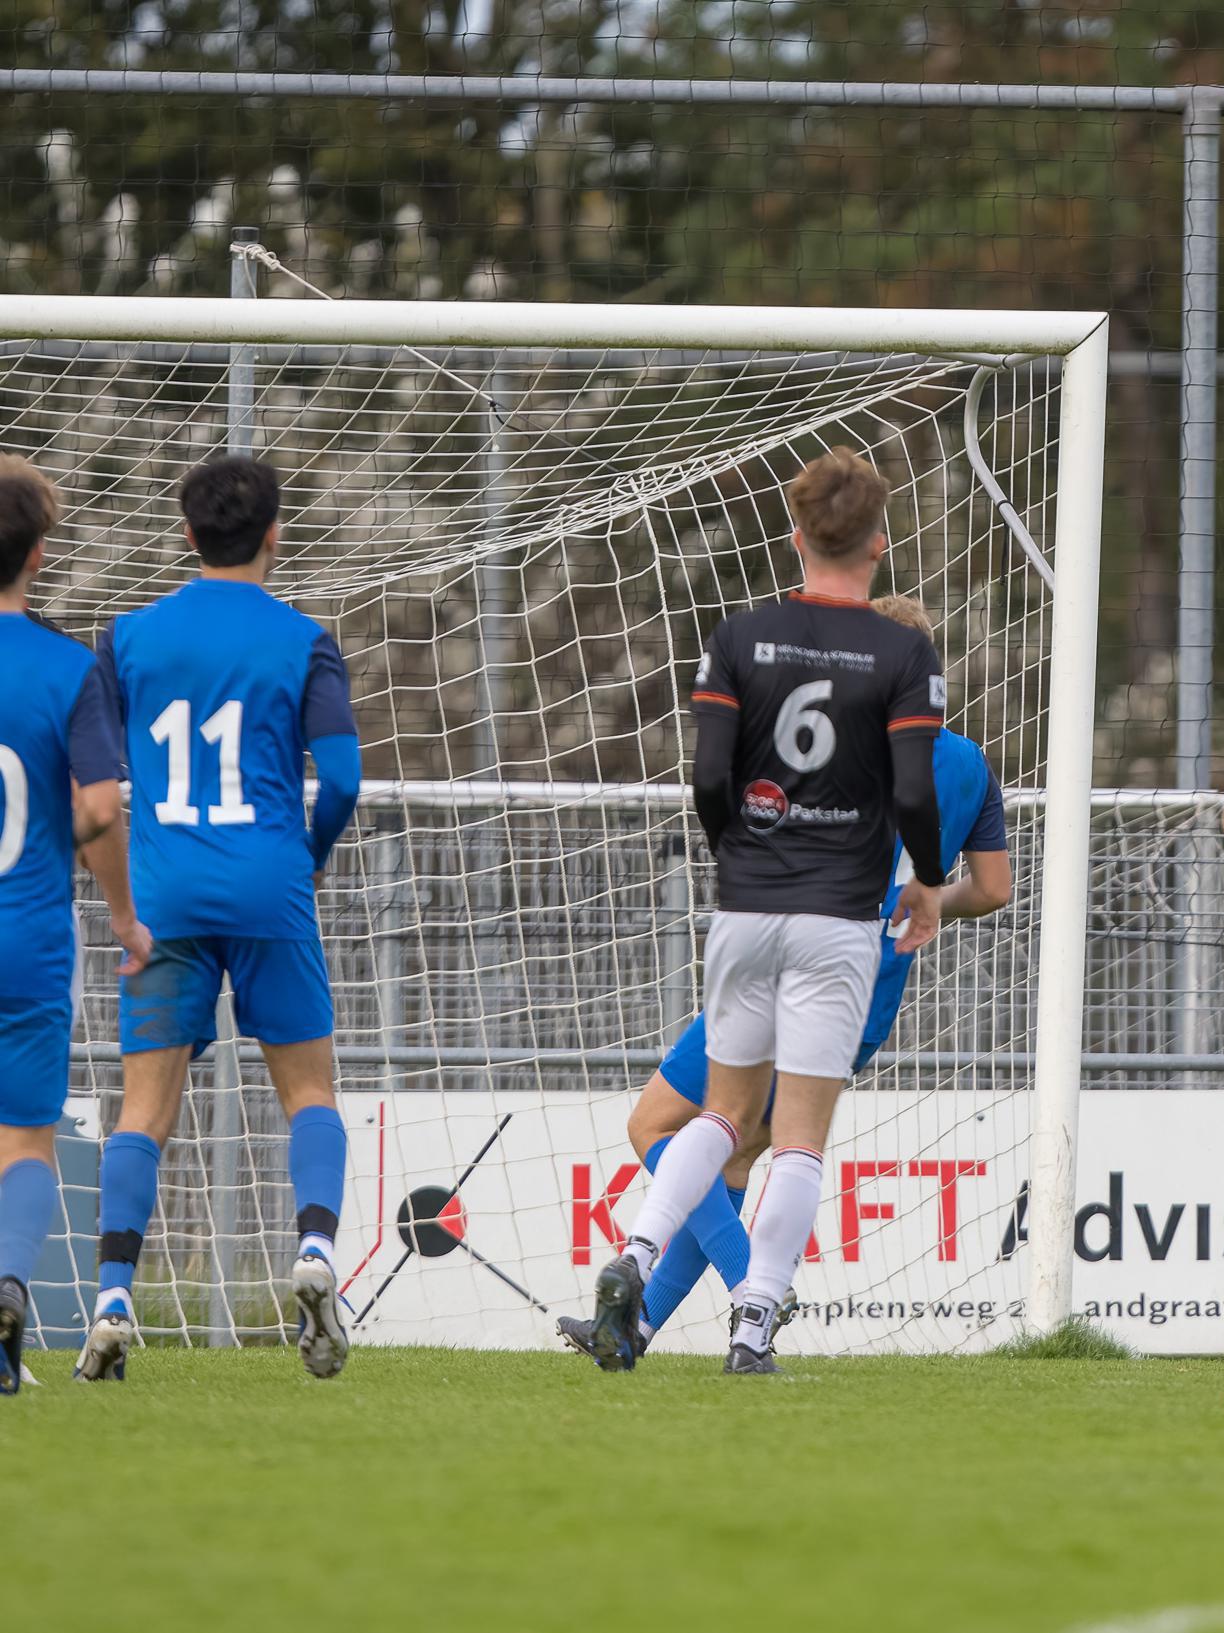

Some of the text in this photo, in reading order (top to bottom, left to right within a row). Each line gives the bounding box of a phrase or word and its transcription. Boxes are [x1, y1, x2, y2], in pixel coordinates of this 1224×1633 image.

[149, 699, 256, 827] 11
[773, 679, 837, 774] 6
[571, 1159, 987, 1266] KFT
[792, 1296, 996, 1327] mpkensweg
